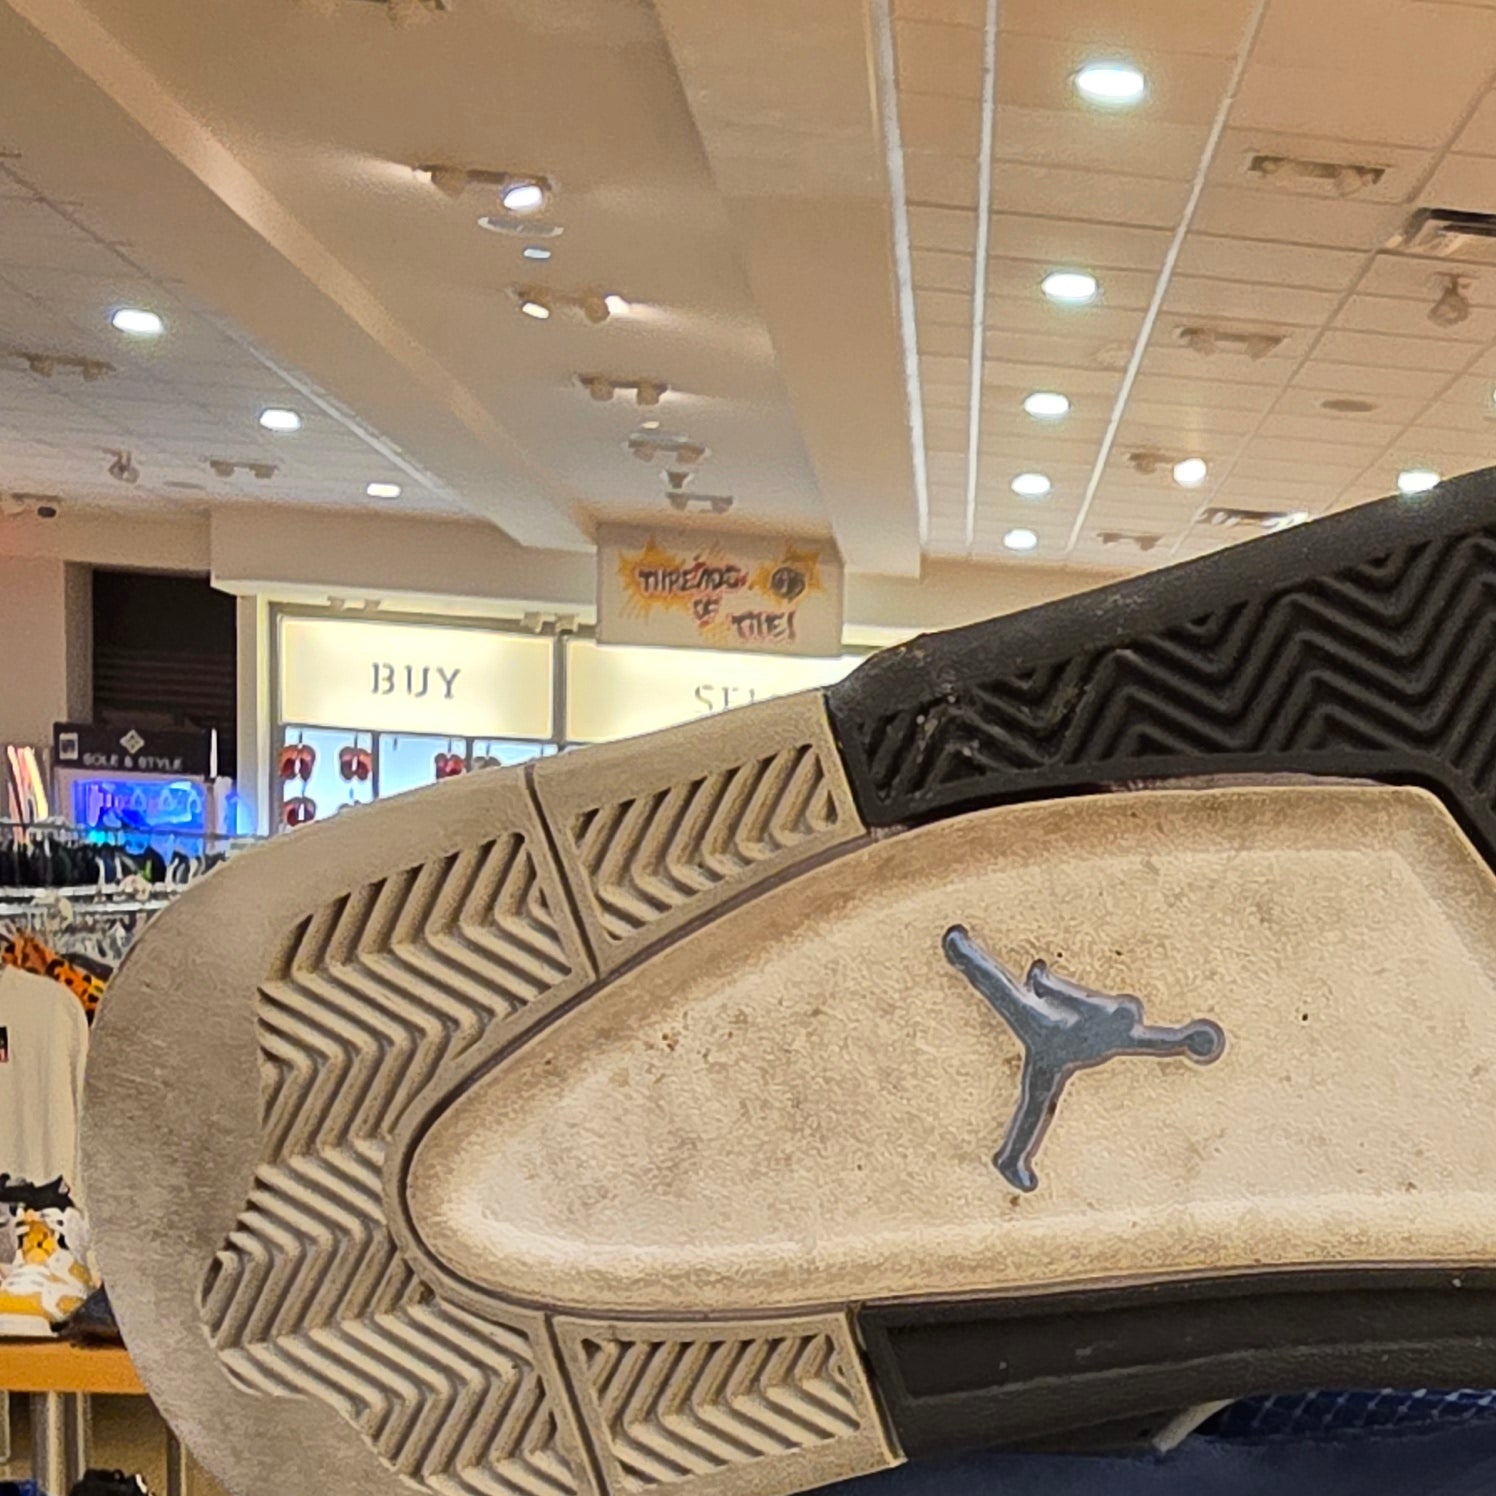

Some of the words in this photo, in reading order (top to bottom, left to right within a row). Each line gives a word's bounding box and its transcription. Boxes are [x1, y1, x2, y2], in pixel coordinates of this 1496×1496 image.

[372, 662, 461, 699] BUY
[83, 752, 118, 768] SOLE
[138, 756, 183, 771] STYLE
